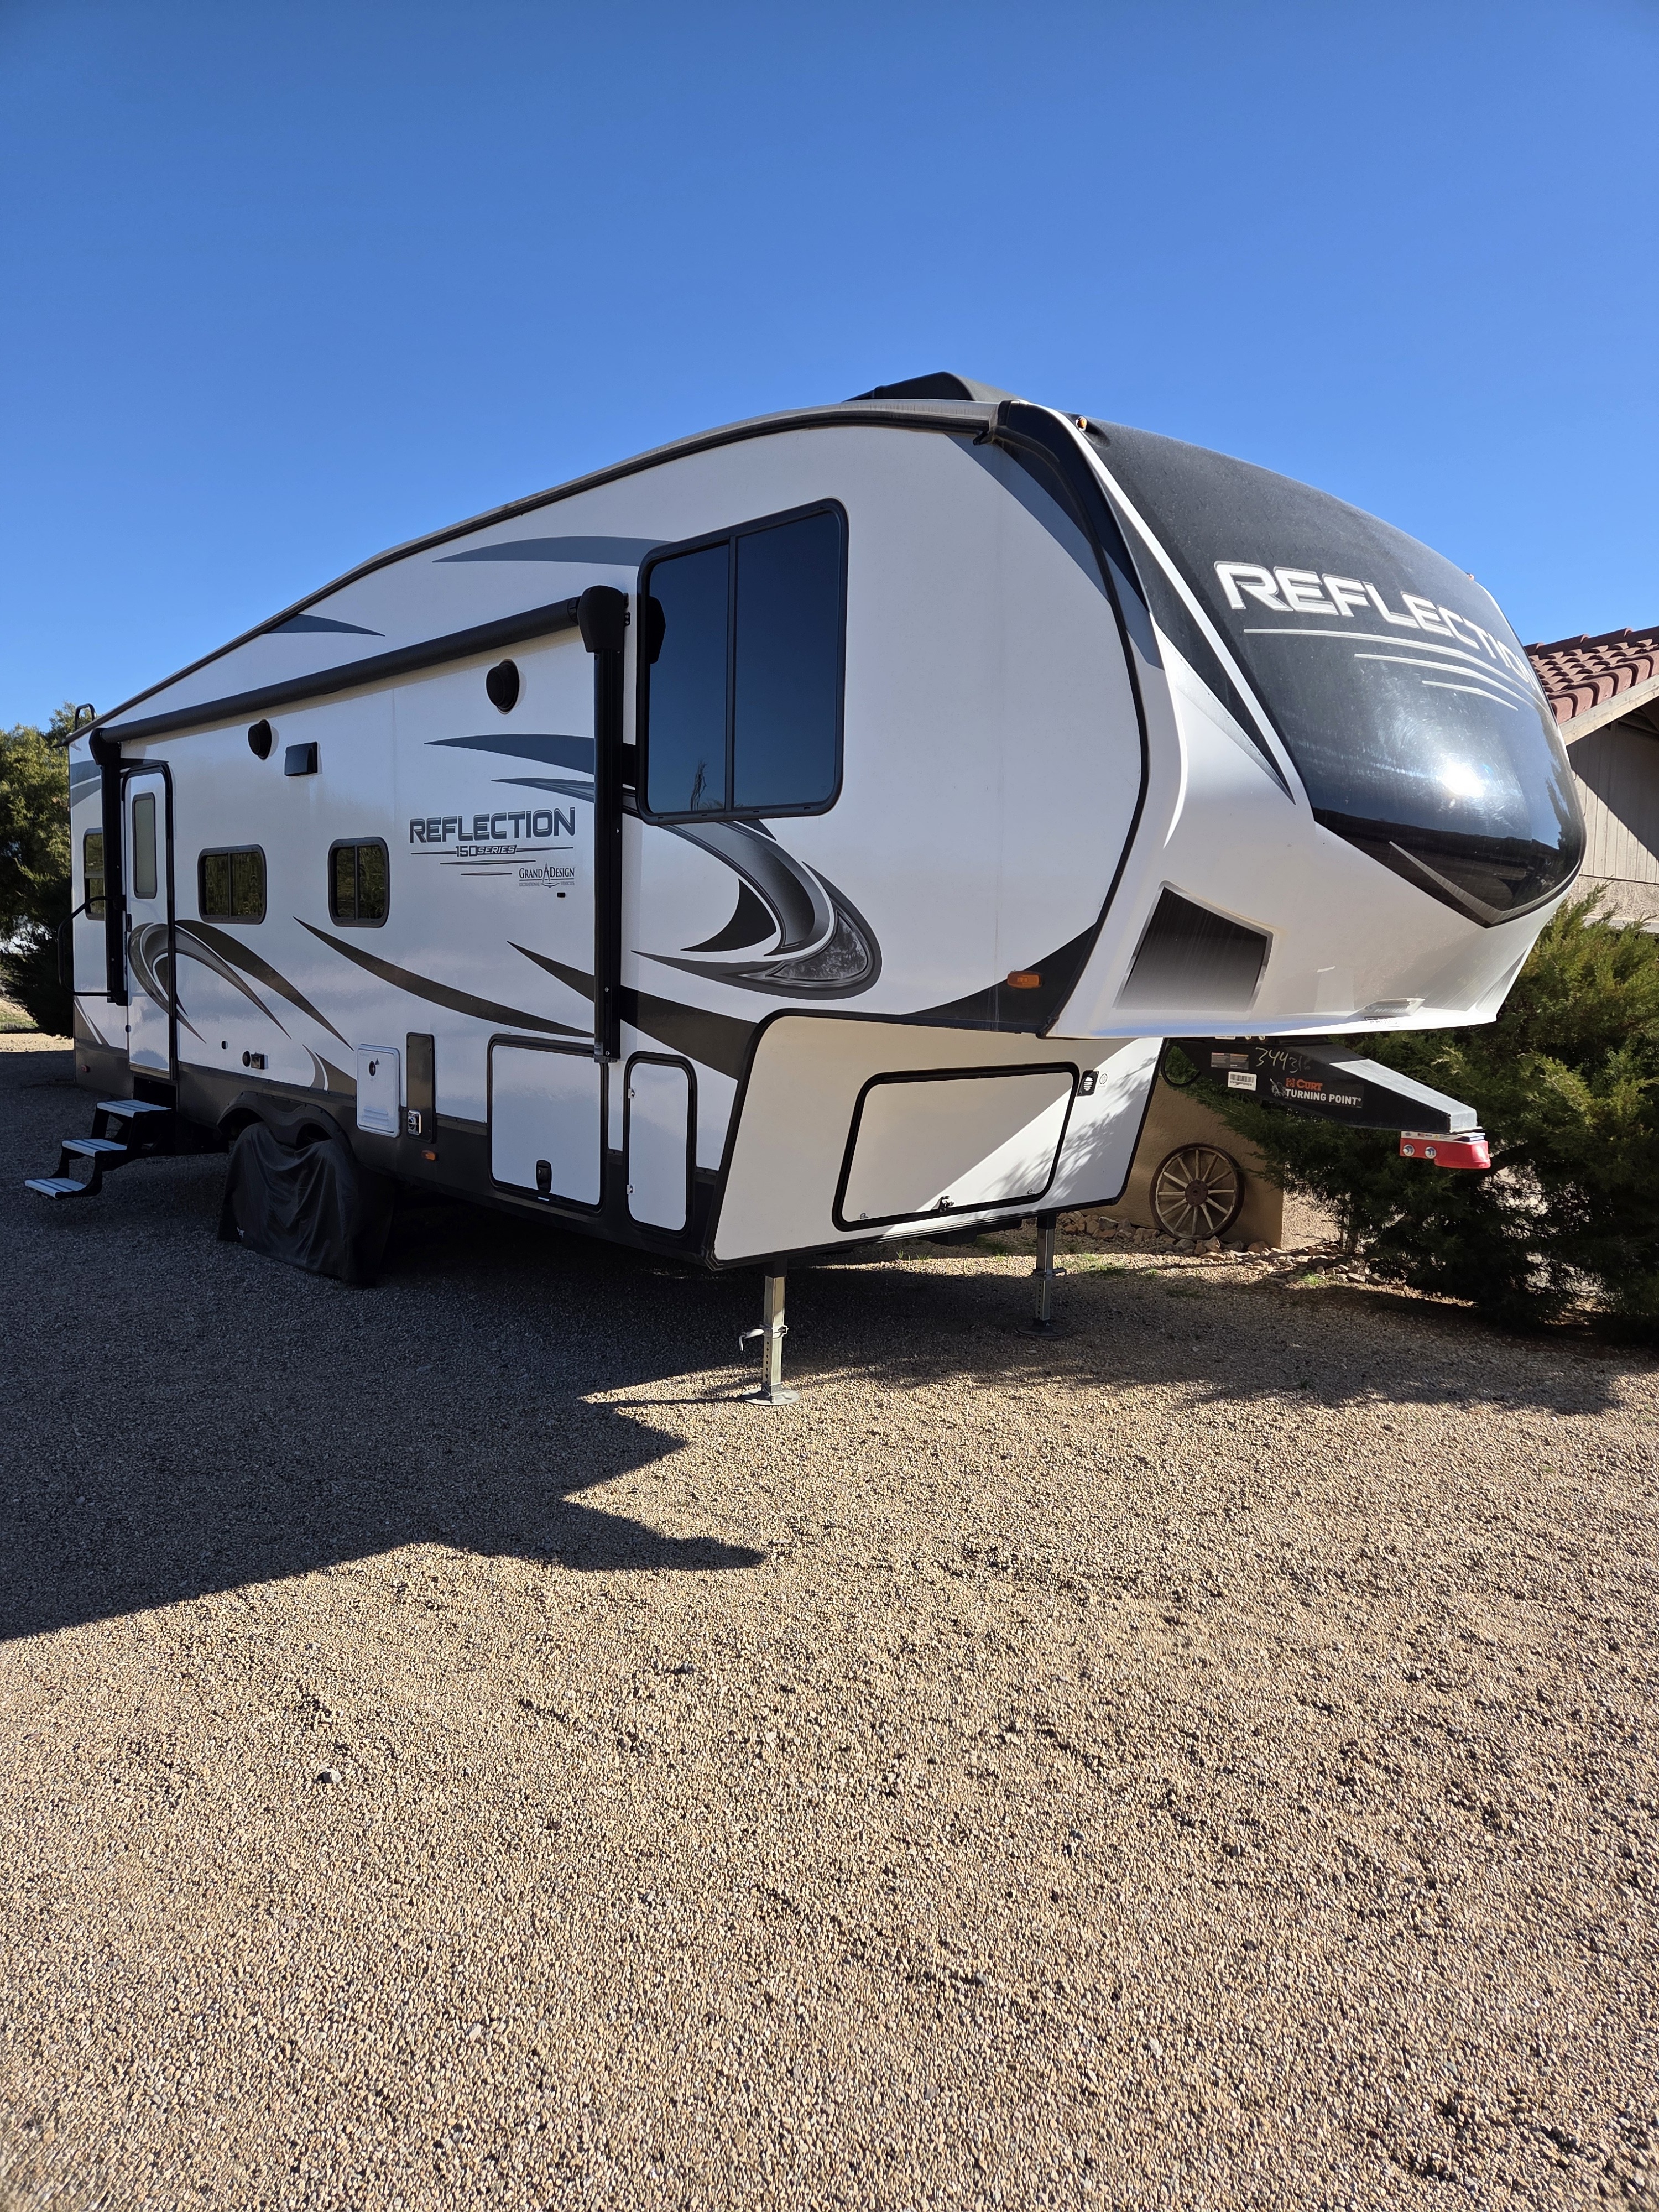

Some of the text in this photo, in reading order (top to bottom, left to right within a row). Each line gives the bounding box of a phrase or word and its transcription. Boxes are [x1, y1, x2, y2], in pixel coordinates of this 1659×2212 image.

[410, 807, 575, 843] REFLECTION
[456, 846, 516, 857] 150 SERIES
[519, 867, 575, 878] GRAND DESIGN
[1296, 1079, 1323, 1091] CURT
[1285, 1088, 1327, 1102] TURNING
